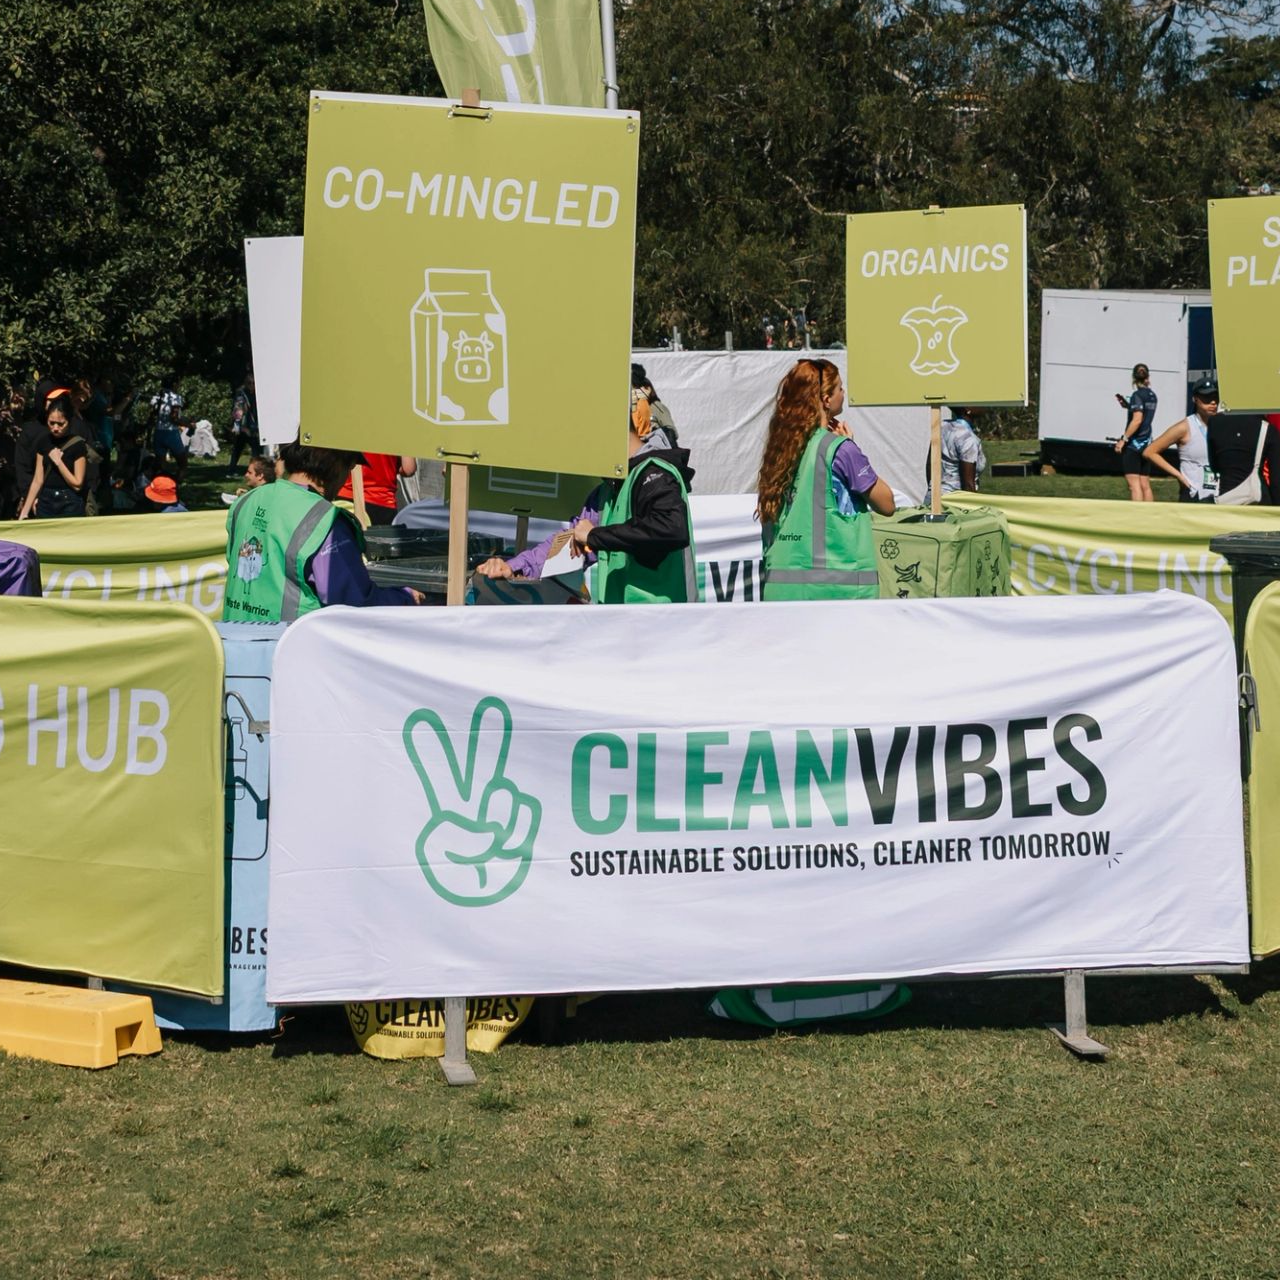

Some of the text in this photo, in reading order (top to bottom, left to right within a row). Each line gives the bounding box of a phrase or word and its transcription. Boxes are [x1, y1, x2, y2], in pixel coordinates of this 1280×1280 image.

[322, 166, 621, 230] CO-MINGLED
[859, 242, 1011, 279] ORGANICS
[26, 683, 170, 776] HUB
[569, 713, 1108, 835] CLEANVIBES
[569, 830, 1112, 878] SUSTAINABLE SOLUTIONS, CLEANER TOMORROW
[416, 1030, 445, 1040] SOLUTIO
[481, 1023, 512, 1034] TOMORRO
